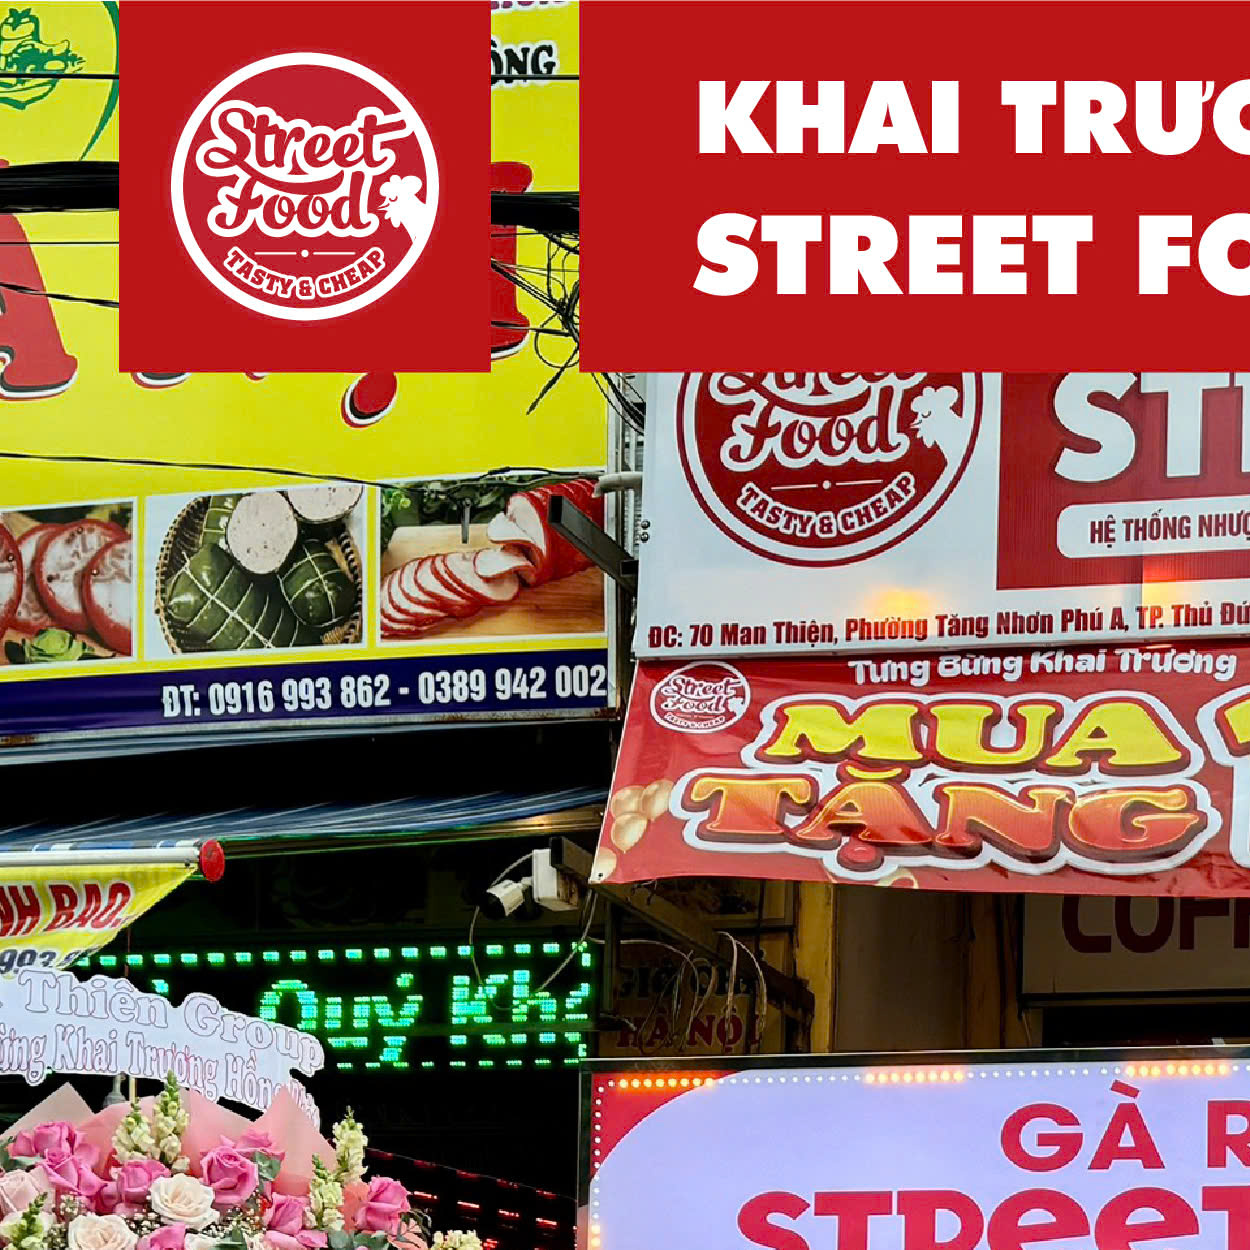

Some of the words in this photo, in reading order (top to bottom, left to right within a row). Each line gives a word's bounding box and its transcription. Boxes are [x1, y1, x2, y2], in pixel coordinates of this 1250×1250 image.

[727, 384, 902, 464] Food
[741, 484, 811, 537] TASTY
[819, 514, 836, 535] &
[840, 474, 914, 534] CHEAP
[1090, 513, 1117, 548] HỆ
[1124, 508, 1191, 542] THỐNG
[648, 625, 683, 649] ĐC:
[689, 623, 713, 648] 70
[720, 622, 767, 647] Man
[772, 619, 838, 648] Thiện,
[845, 616, 928, 642] Phường
[935, 613, 989, 639] Tăng
[996, 611, 1054, 635] Nhơn
[1061, 606, 1104, 633] Phú
[1110, 607, 1129, 633] A,
[1136, 605, 1164, 631] TP.
[1171, 600, 1213, 627] Thủ
[162, 686, 201, 717] ĐT:
[209, 681, 273, 716] 0916
[282, 677, 332, 712] 993
[340, 674, 391, 709] 862
[398, 686, 410, 694] -
[419, 669, 486, 704] 0389
[494, 666, 547, 700] 942
[556, 664, 608, 698] 002
[661, 677, 741, 697] Street
[1029, 649, 1106, 673] Khai
[1115, 649, 1238, 681] Trương
[755, 699, 1191, 772] MUA
[682, 766, 1208, 871] TẶNG
[18, 969, 168, 1029] Thiên
[184, 992, 323, 1073] Group
[55, 1024, 118, 1072] Khai
[125, 1031, 220, 1096] Trương
[1000, 1079, 1165, 1173] GÀ
